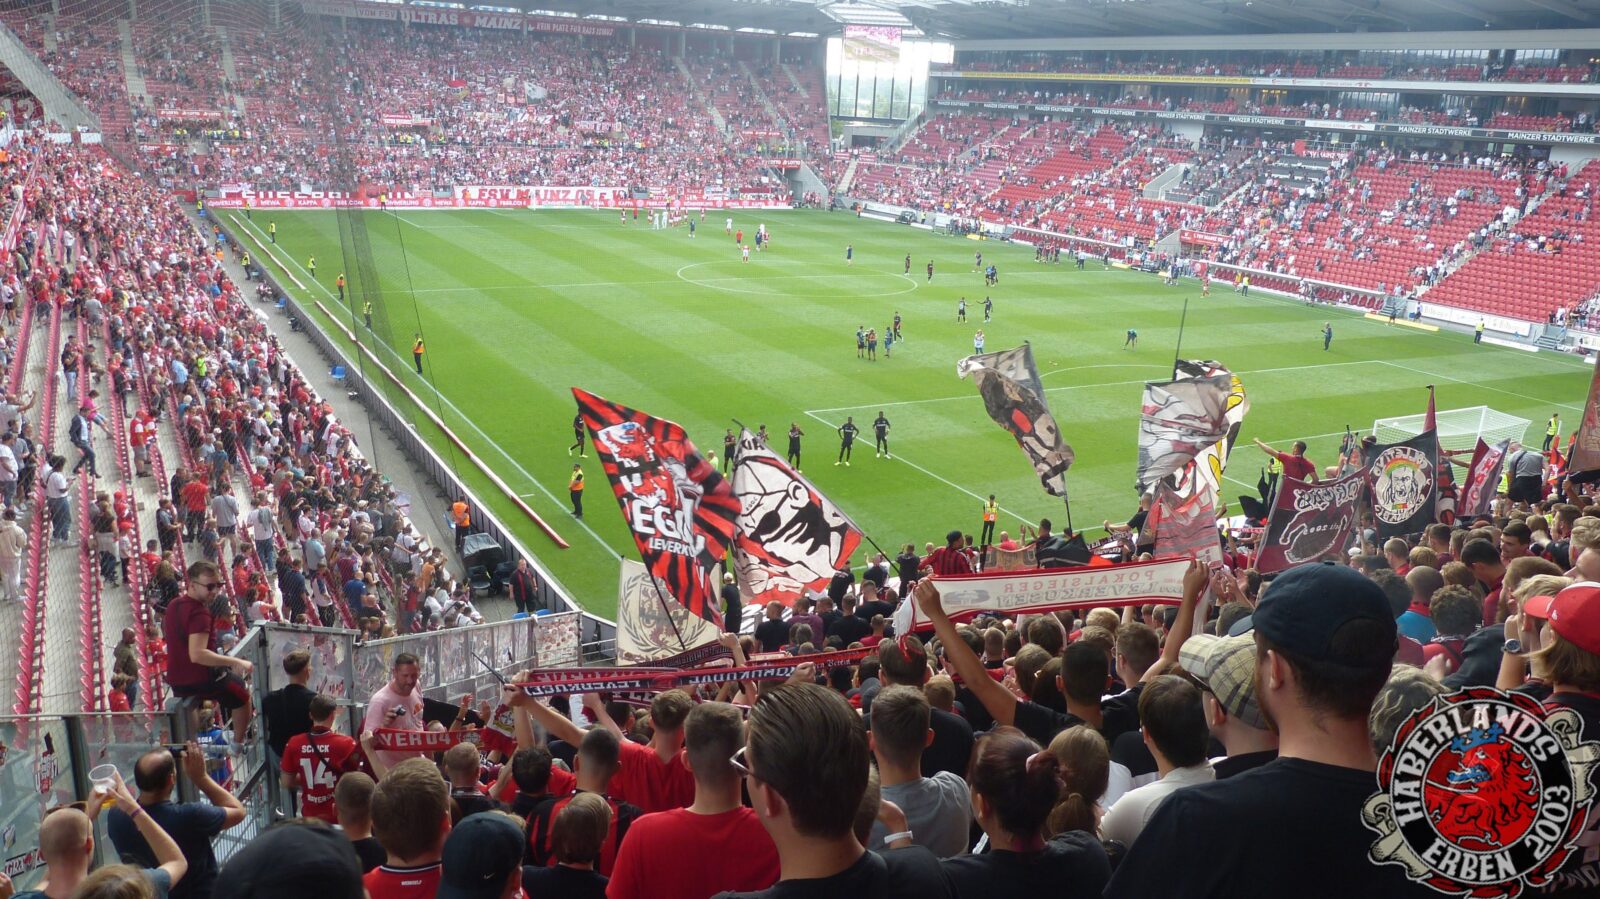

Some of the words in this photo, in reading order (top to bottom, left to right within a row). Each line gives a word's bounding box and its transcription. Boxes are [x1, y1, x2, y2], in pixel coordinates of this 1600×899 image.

[401, 10, 458, 25] ULTRAS
[474, 15, 521, 29] MAINZ
[1398, 126, 1426, 134] MAINZER
[1428, 128, 1472, 136] STADTWERKE
[1508, 132, 1542, 141] MAINZER
[1543, 134, 1595, 143] STADTWERKE
[300, 758, 337, 790] 14
